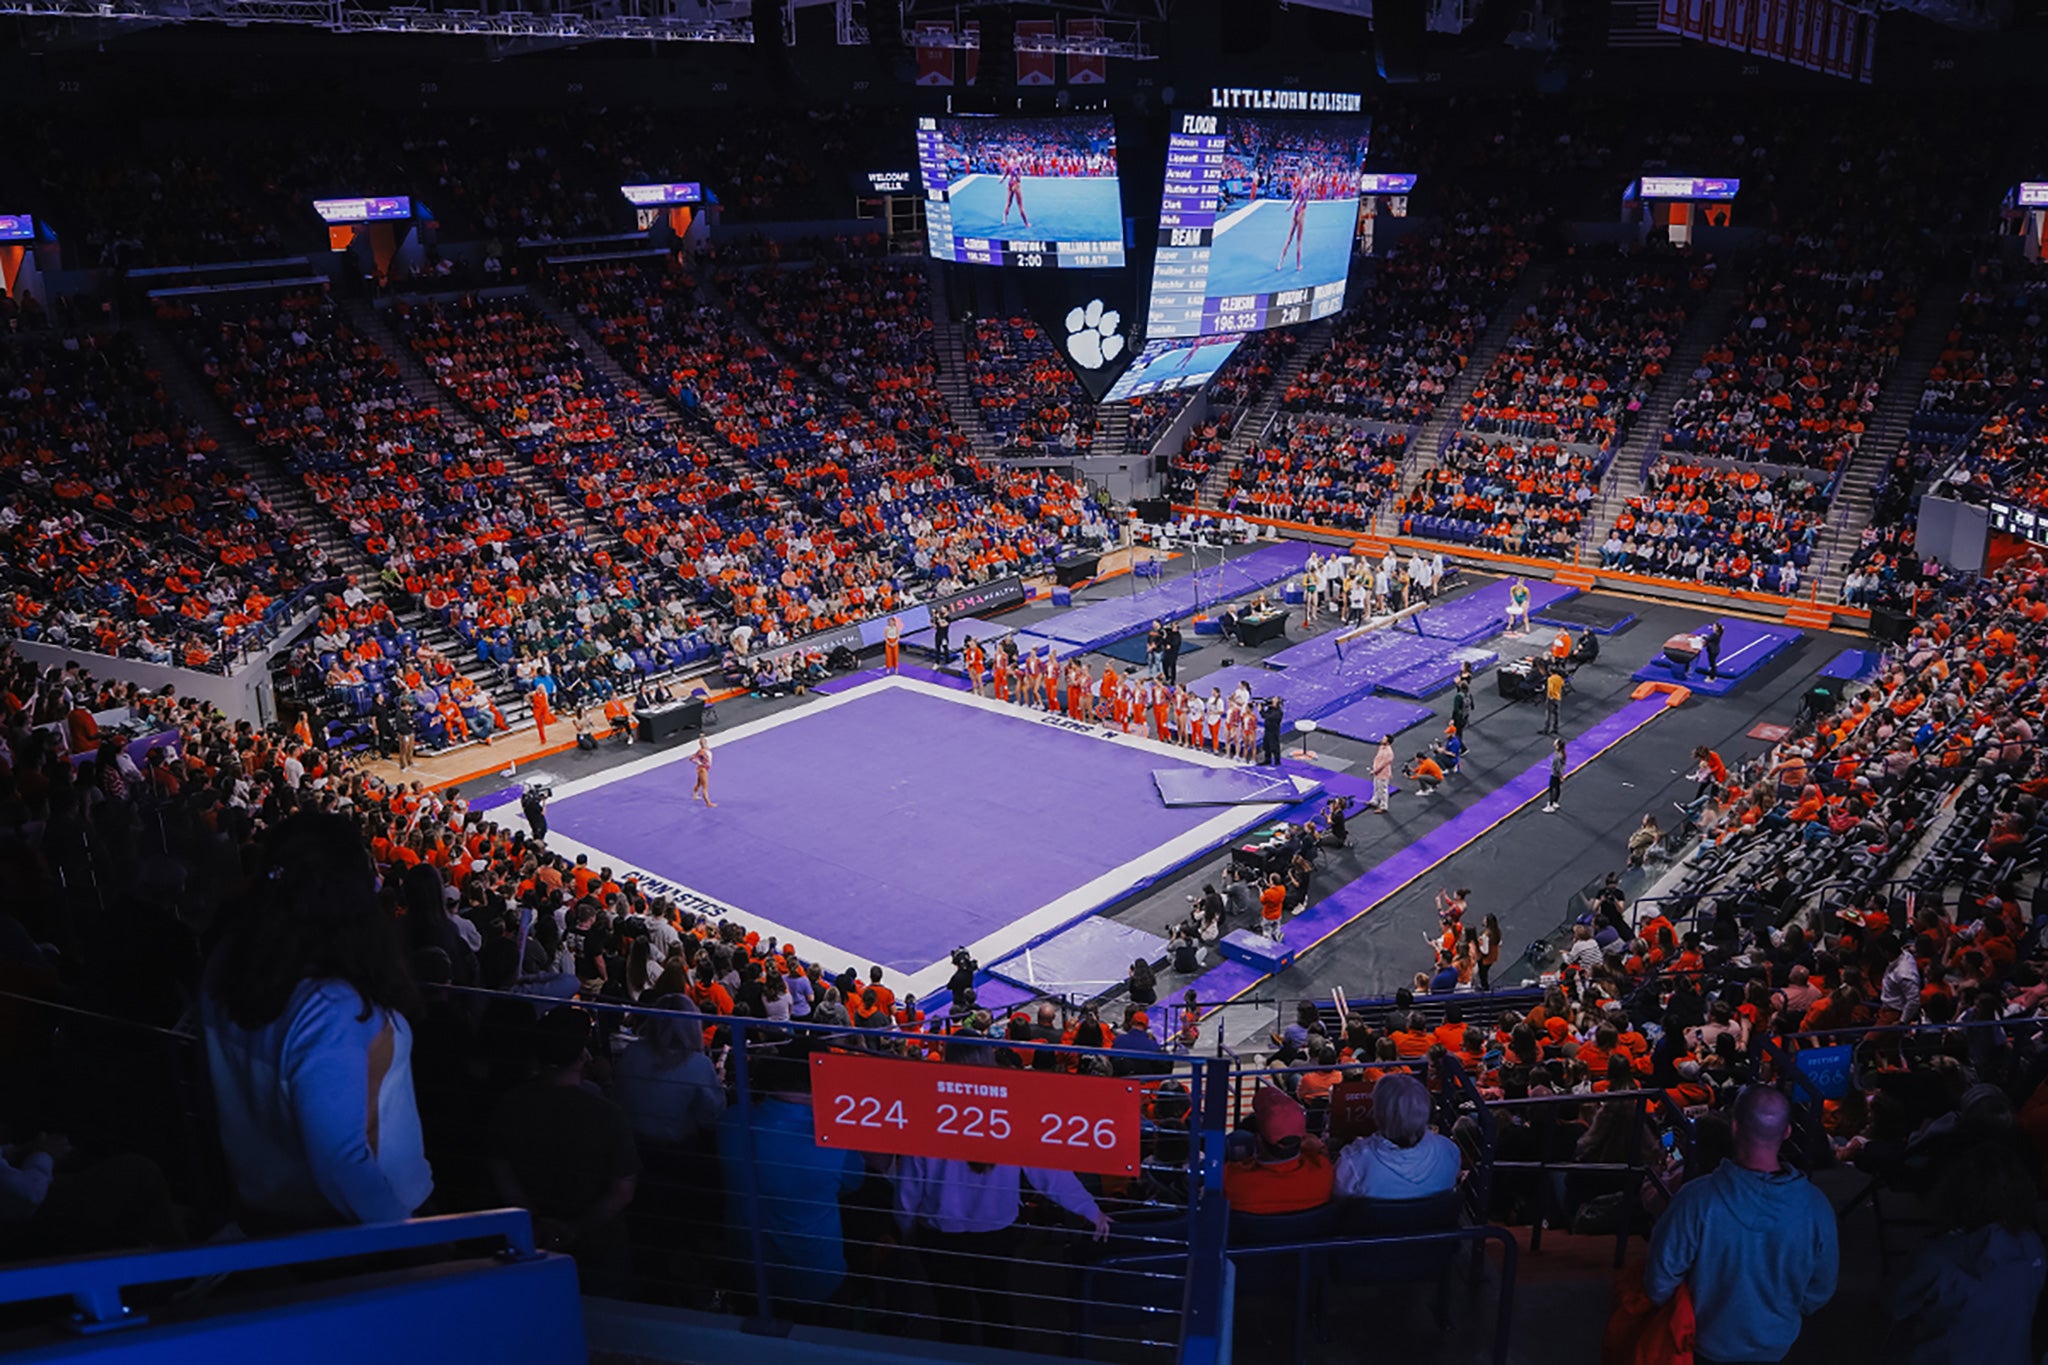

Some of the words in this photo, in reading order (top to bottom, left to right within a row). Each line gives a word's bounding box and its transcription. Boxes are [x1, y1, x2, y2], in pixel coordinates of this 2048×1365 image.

[58, 81, 80, 91] 212
[1212, 88, 1307, 109] LITTLEJOHN
[1310, 93, 1361, 111] COLISEUM
[1182, 115, 1217, 134] FLOOR
[868, 172, 910, 182] WELCOME
[1166, 169, 1192, 178] Arnold
[1171, 228, 1202, 246] BEAM
[1016, 254, 1042, 267] 2:00
[1220, 296, 1256, 311] CLEMSON
[1214, 313, 1257, 332] 196.325
[1281, 307, 1301, 323] 2:00
[1041, 715, 1119, 739] CLEMSN
[621, 871, 728, 918] GYMNSTICS
[936, 1080, 1008, 1098] SECTIONS
[834, 1094, 909, 1130] 224
[936, 1103, 1012, 1140] 225
[1040, 1113, 1117, 1150] 226
